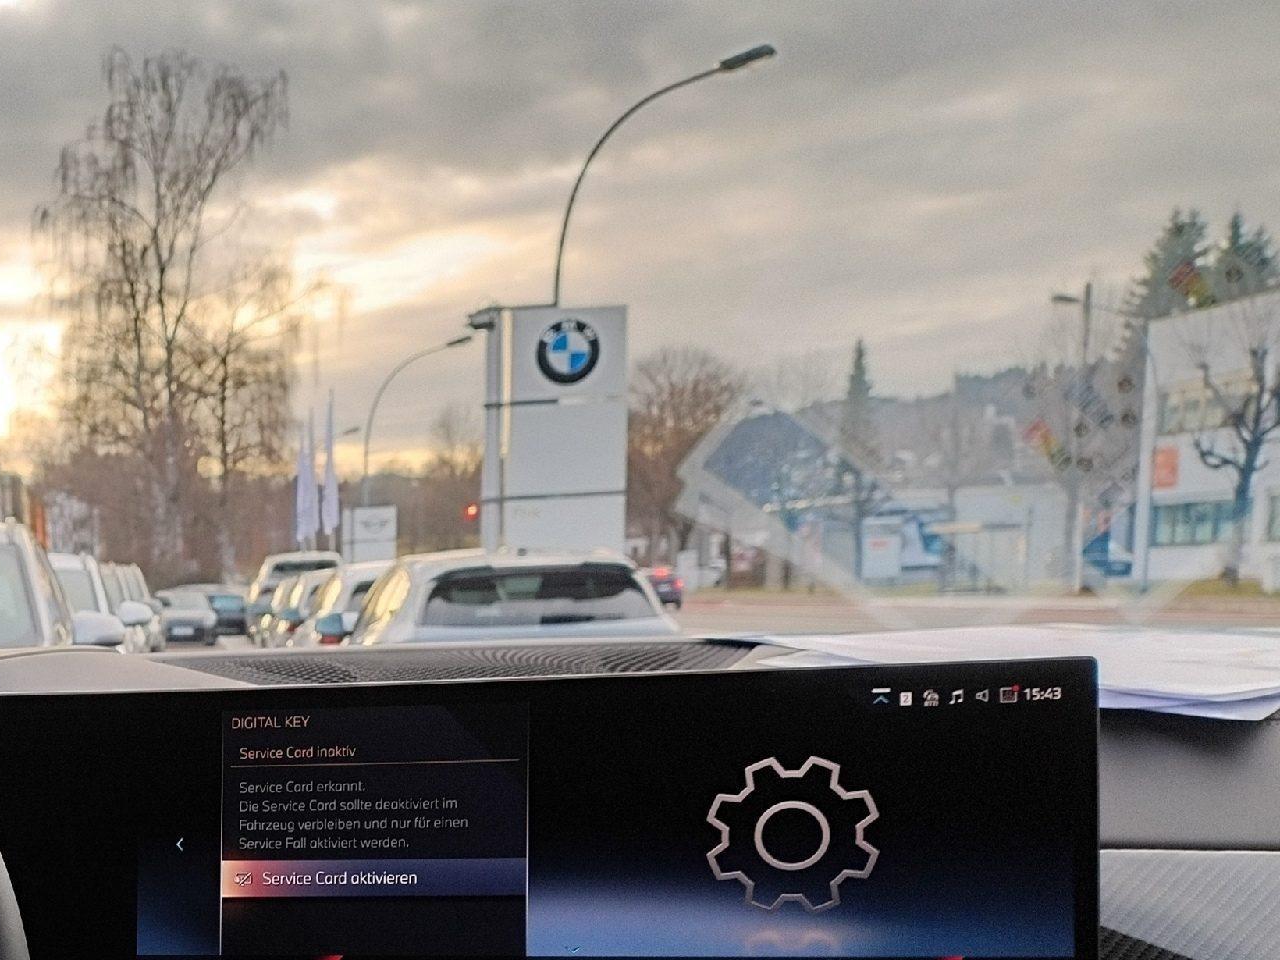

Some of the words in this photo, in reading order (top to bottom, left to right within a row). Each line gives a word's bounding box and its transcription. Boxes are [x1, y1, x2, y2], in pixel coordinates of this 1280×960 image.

[1023, 687, 1062, 701] 15:43
[231, 717, 281, 730] DIGITAL
[284, 715, 311, 728] KEY
[238, 748, 283, 760] Service
[286, 747, 313, 759] Card
[316, 745, 356, 758] inaktiv
[238, 781, 283, 794] Service
[285, 780, 313, 793] Card
[316, 780, 365, 793] erkannt.
[239, 800, 259, 813] Die
[261, 799, 305, 812] Service
[309, 799, 337, 811] Card
[339, 798, 372, 811] sollte
[375, 797, 439, 810] deaktiviert
[442, 797, 458, 809] im
[239, 819, 295, 833] Fahrzeug
[297, 817, 361, 831] verbleiben
[363, 817, 388, 830] und
[391, 818, 411, 829] nur
[413, 816, 431, 829] für
[433, 816, 469, 828] einen
[238, 838, 282, 850] Service
[285, 837, 307, 849] Fall
[309, 836, 358, 849] aktiviert
[360, 835, 410, 848] werden.
[262, 871, 312, 885] Service
[315, 870, 347, 885] Card
[351, 869, 418, 884] aktivieren
